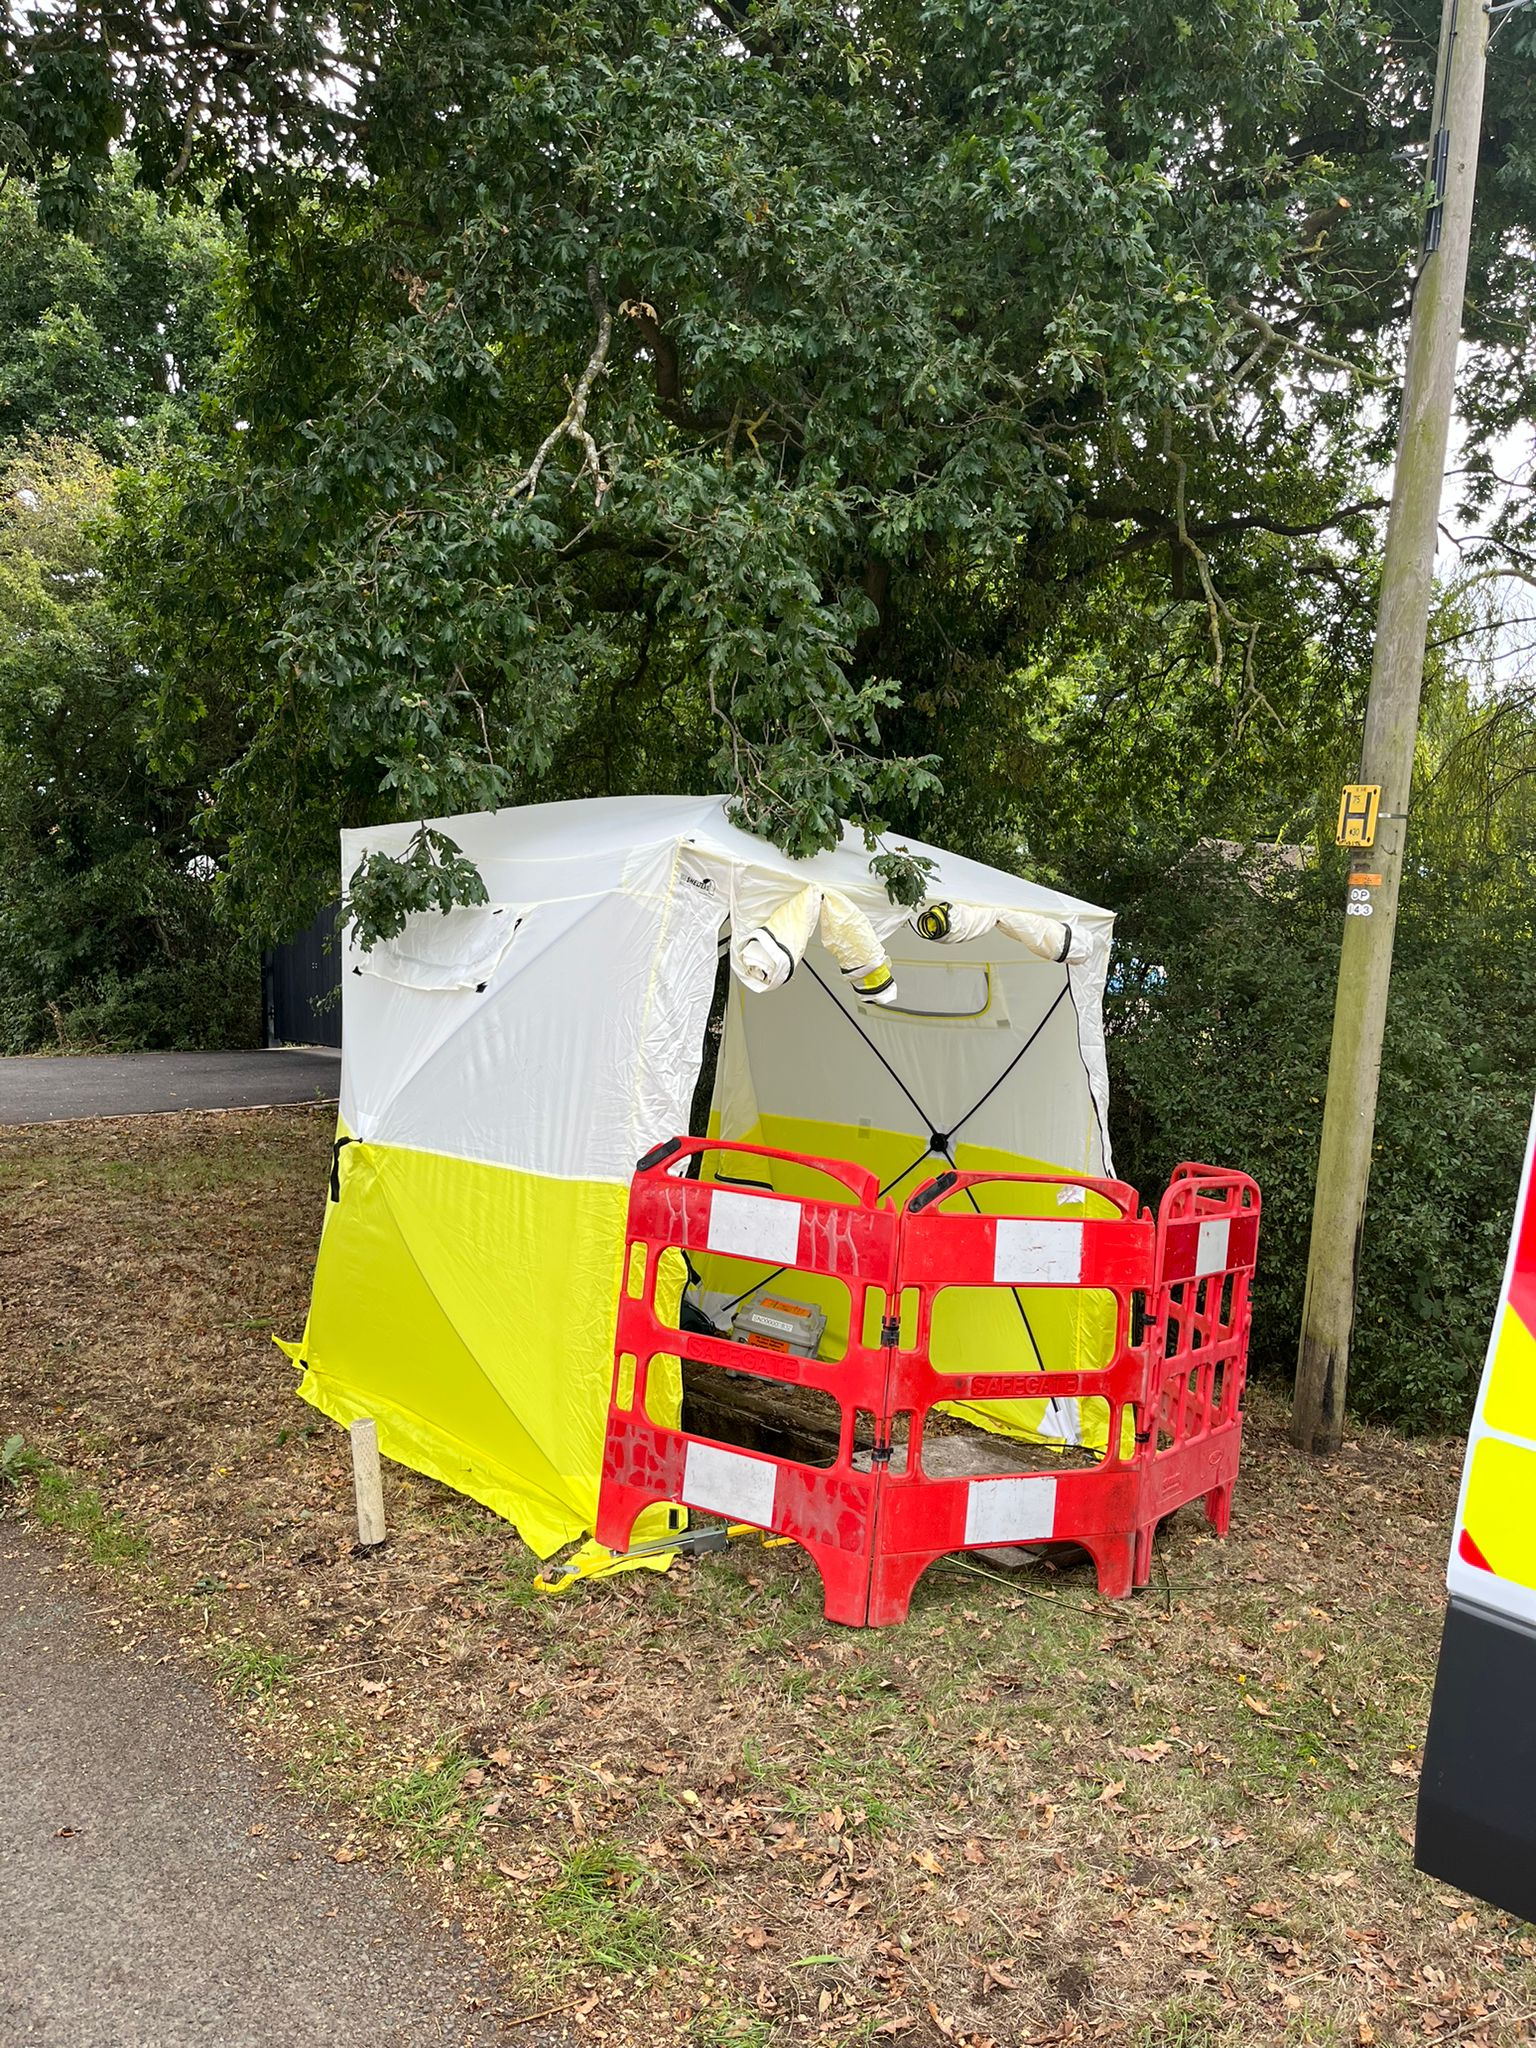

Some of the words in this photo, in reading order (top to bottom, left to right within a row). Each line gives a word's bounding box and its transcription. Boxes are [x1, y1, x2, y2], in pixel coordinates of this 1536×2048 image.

[1341, 792, 1372, 840] H
[1352, 890, 1368, 899] DP
[1348, 904, 1370, 915] 143
[689, 1338, 798, 1378] SAFEGATE
[973, 1375, 1077, 1395] SAFEGATE
